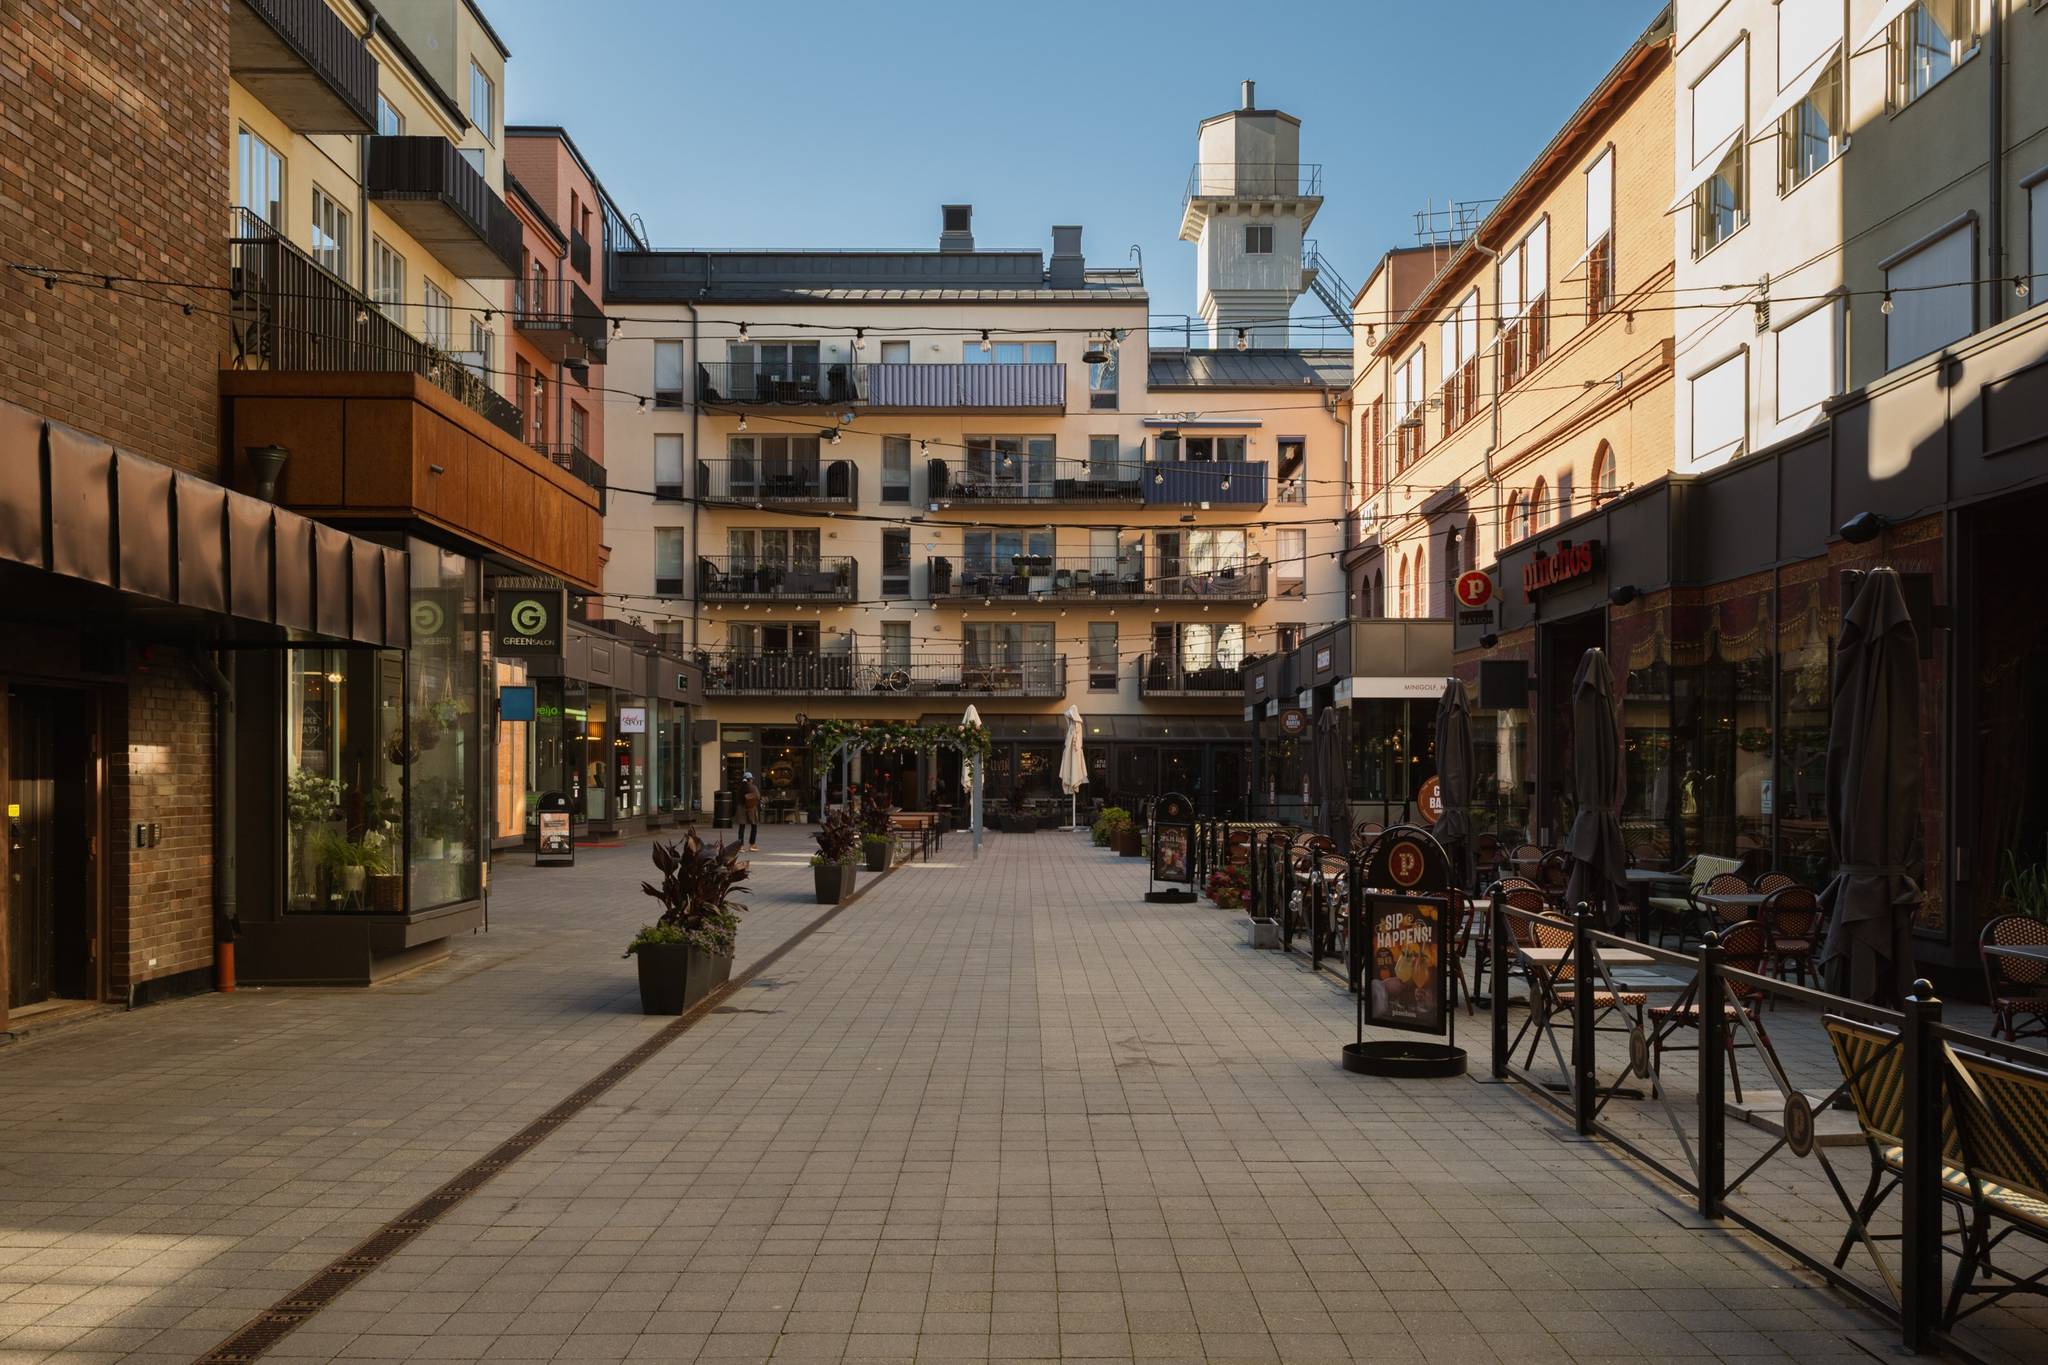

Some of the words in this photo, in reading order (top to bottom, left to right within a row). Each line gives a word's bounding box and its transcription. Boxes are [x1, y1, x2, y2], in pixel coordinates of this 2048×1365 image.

[1522, 542, 1592, 605] pinchos
[518, 606, 541, 629] G
[1385, 912, 1404, 931] SIP
[1376, 926, 1432, 949] HAPPENS!
